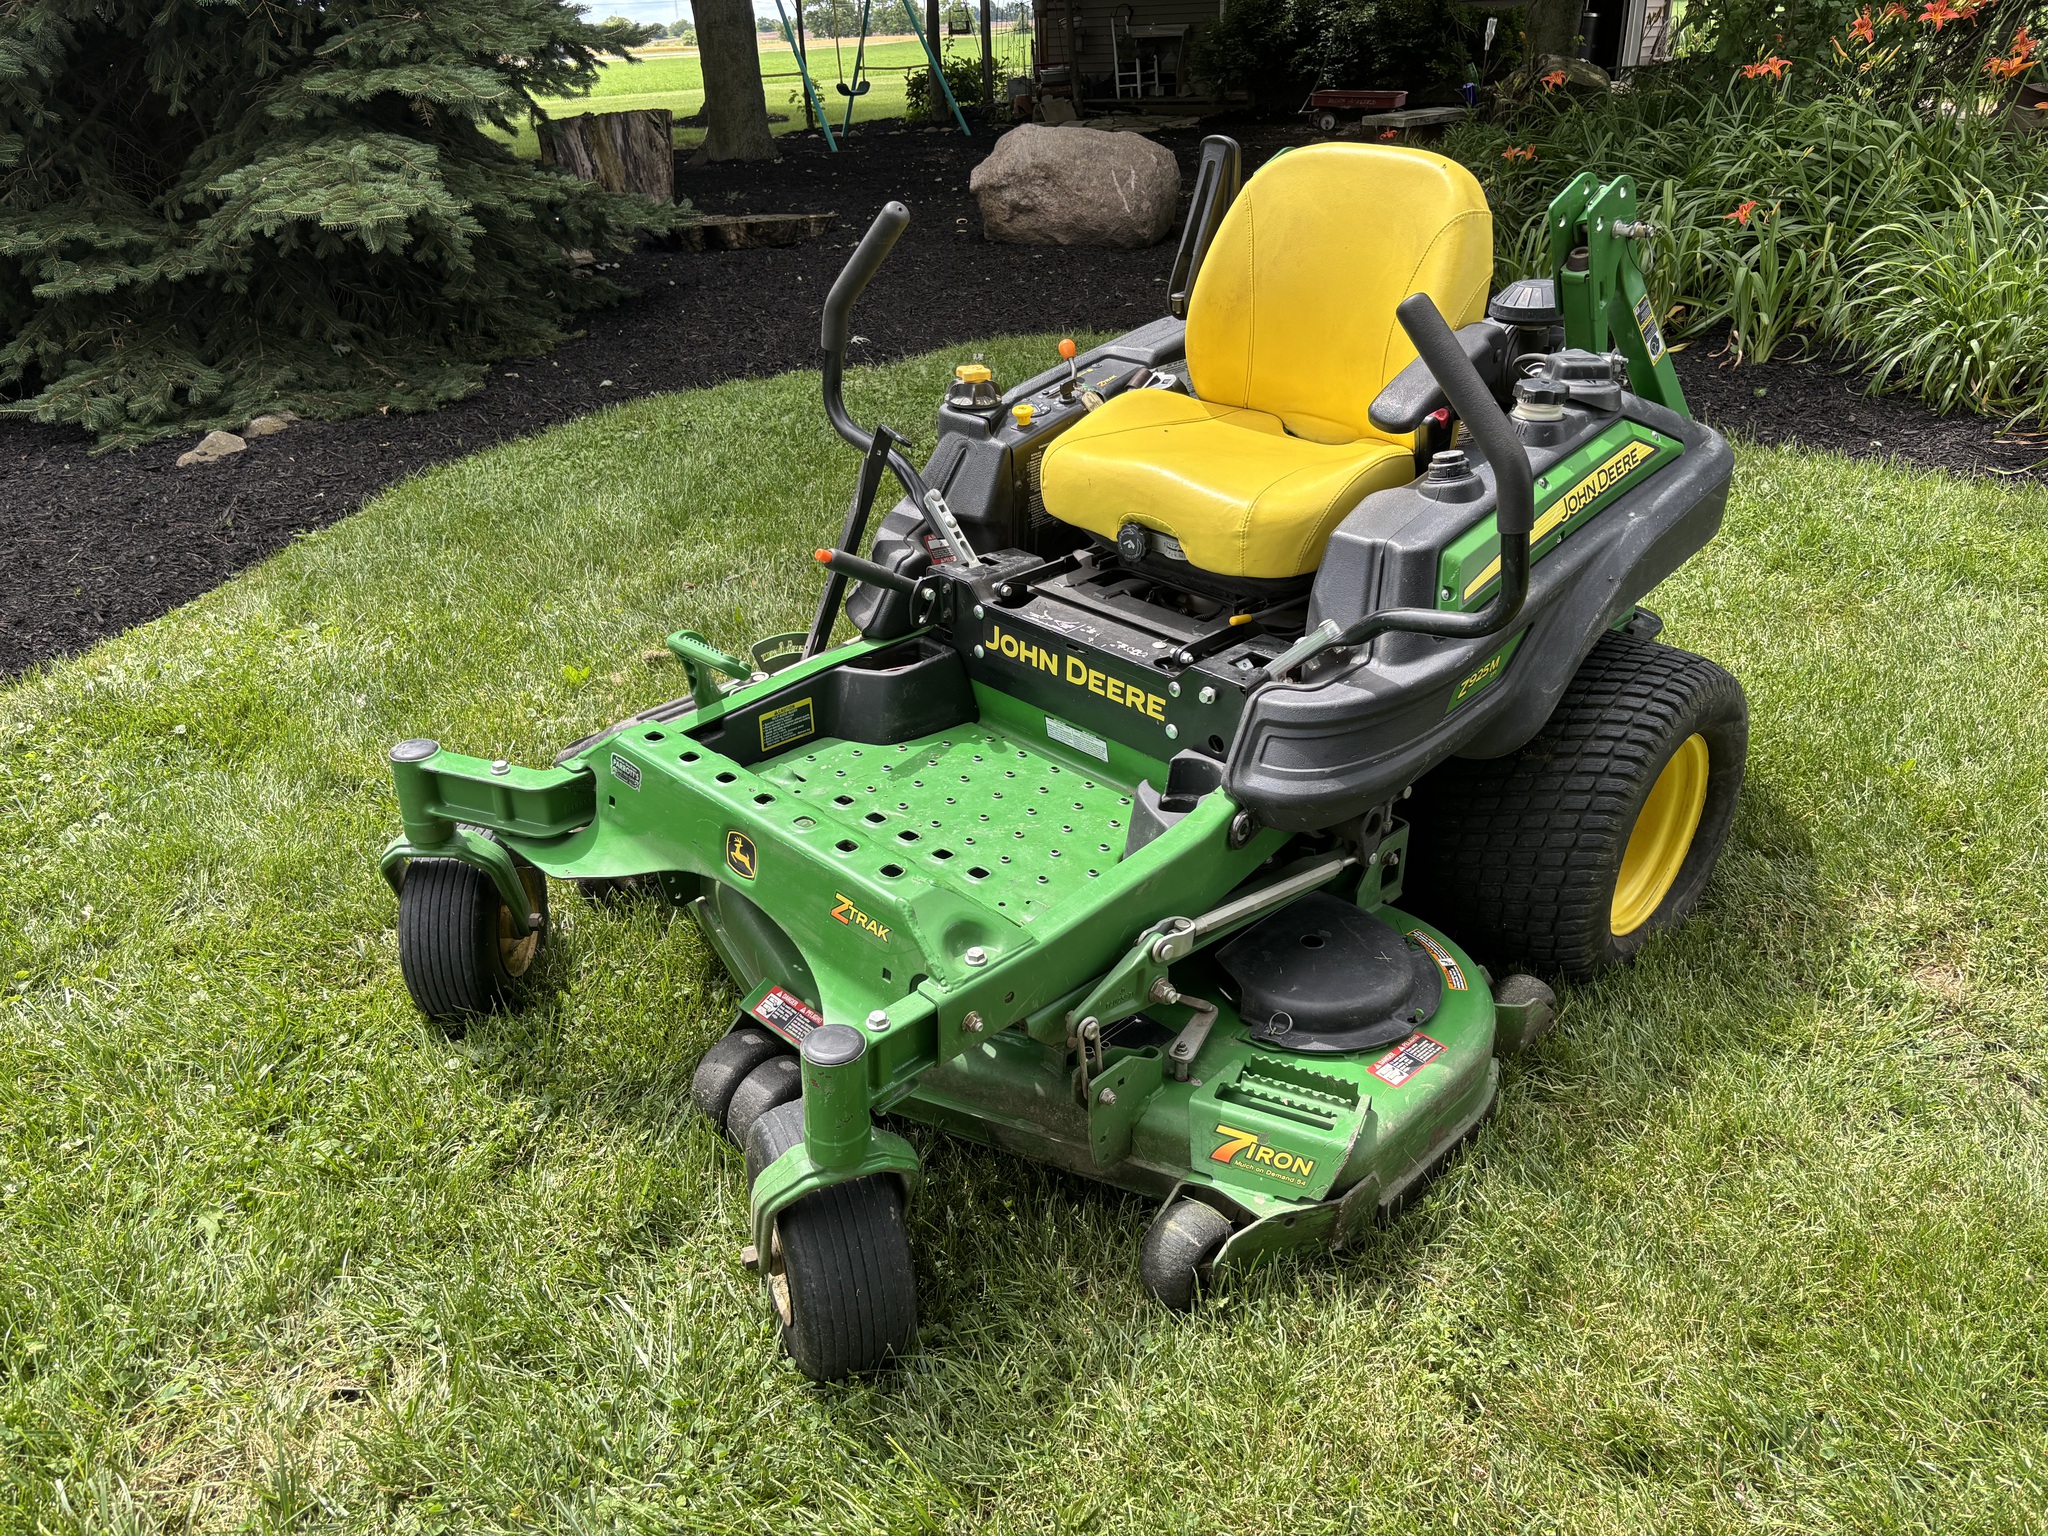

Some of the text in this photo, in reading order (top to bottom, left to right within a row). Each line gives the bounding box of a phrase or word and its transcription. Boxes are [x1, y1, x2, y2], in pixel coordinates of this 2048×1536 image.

[1561, 447, 1640, 521] JOHN DEERE
[984, 624, 1167, 722] JOHN DEERE
[1457, 654, 1501, 700] Z925M
[781, 993, 799, 1007] DANGER
[1234, 1159, 1255, 1170] Mulch
[1265, 1169, 1295, 1183] Demand
